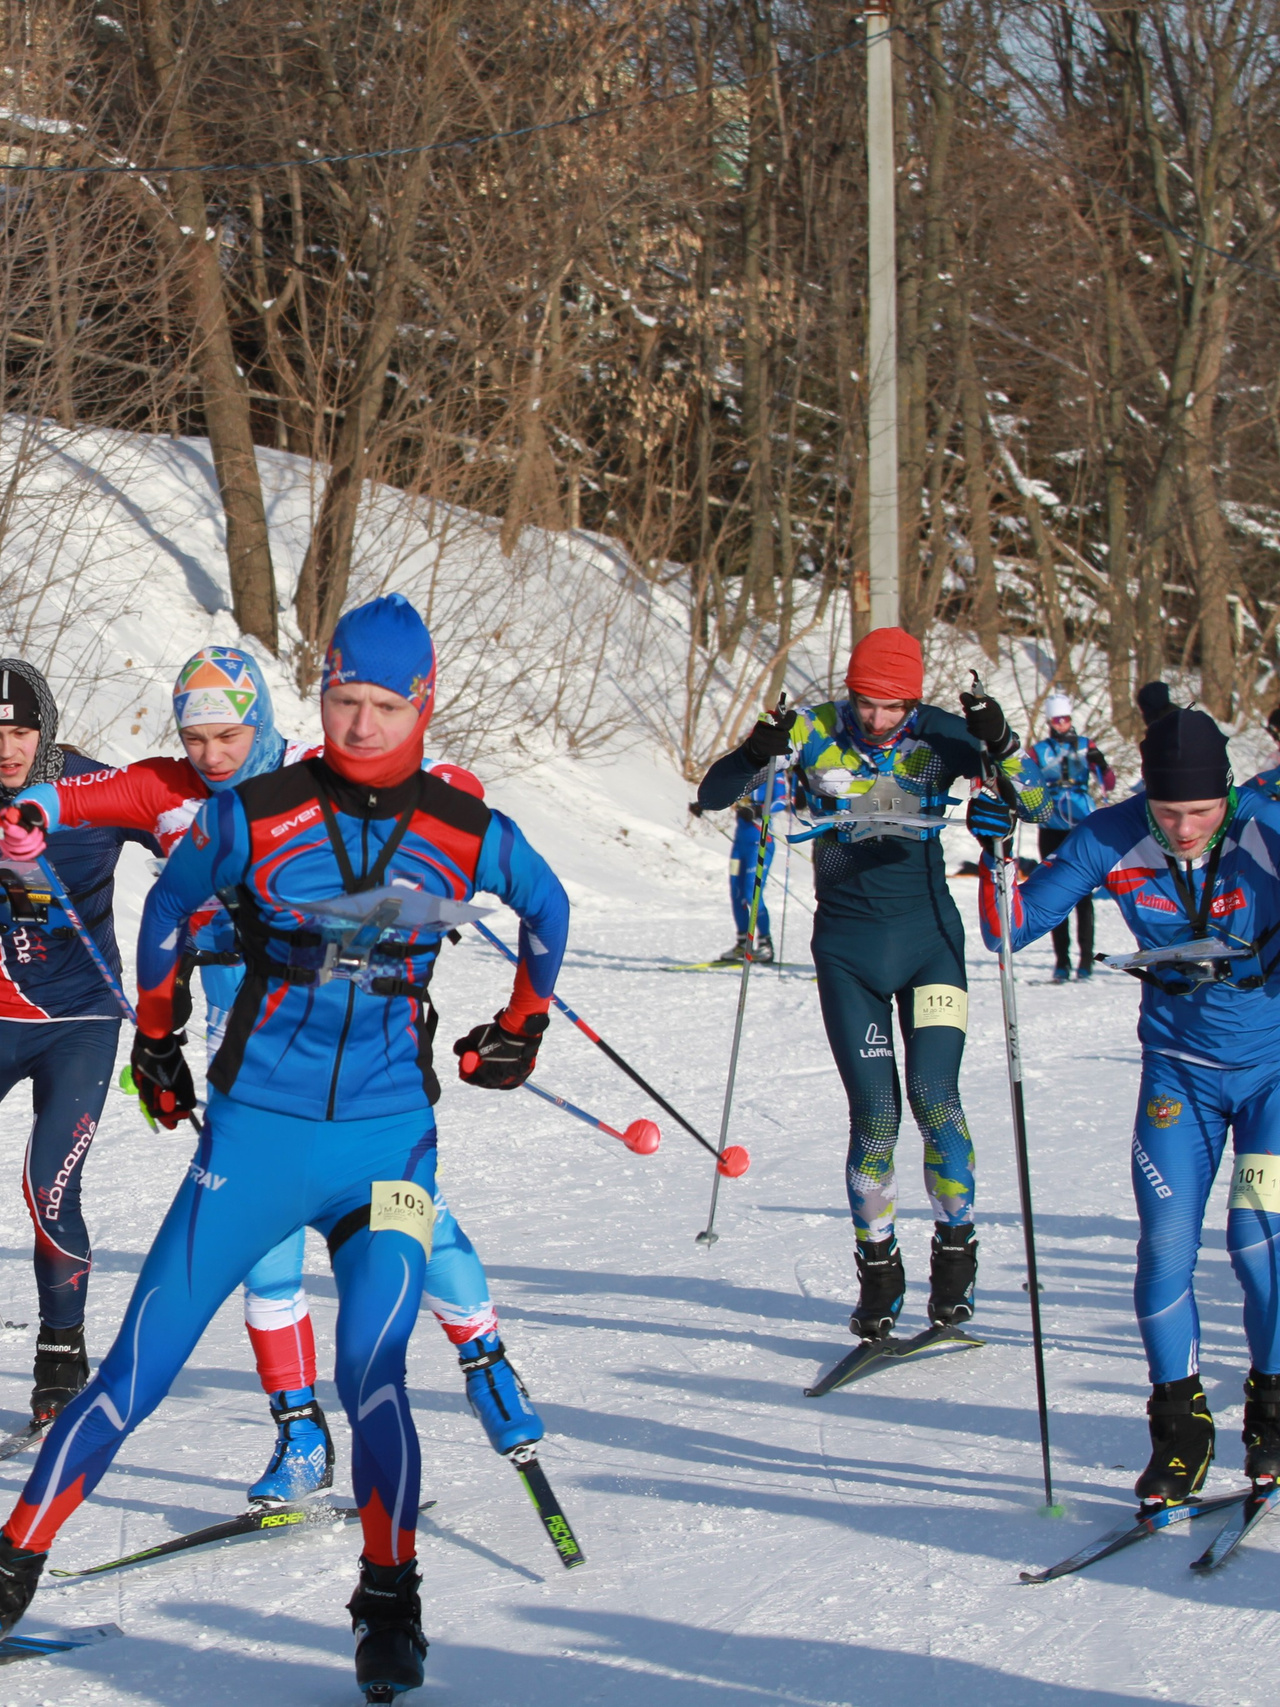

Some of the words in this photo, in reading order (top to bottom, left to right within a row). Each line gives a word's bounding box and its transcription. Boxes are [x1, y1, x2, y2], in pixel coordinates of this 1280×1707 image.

[927, 995, 953, 1008] 112
[1238, 1168, 1264, 1184] 101
[391, 1192, 424, 1216] 103
